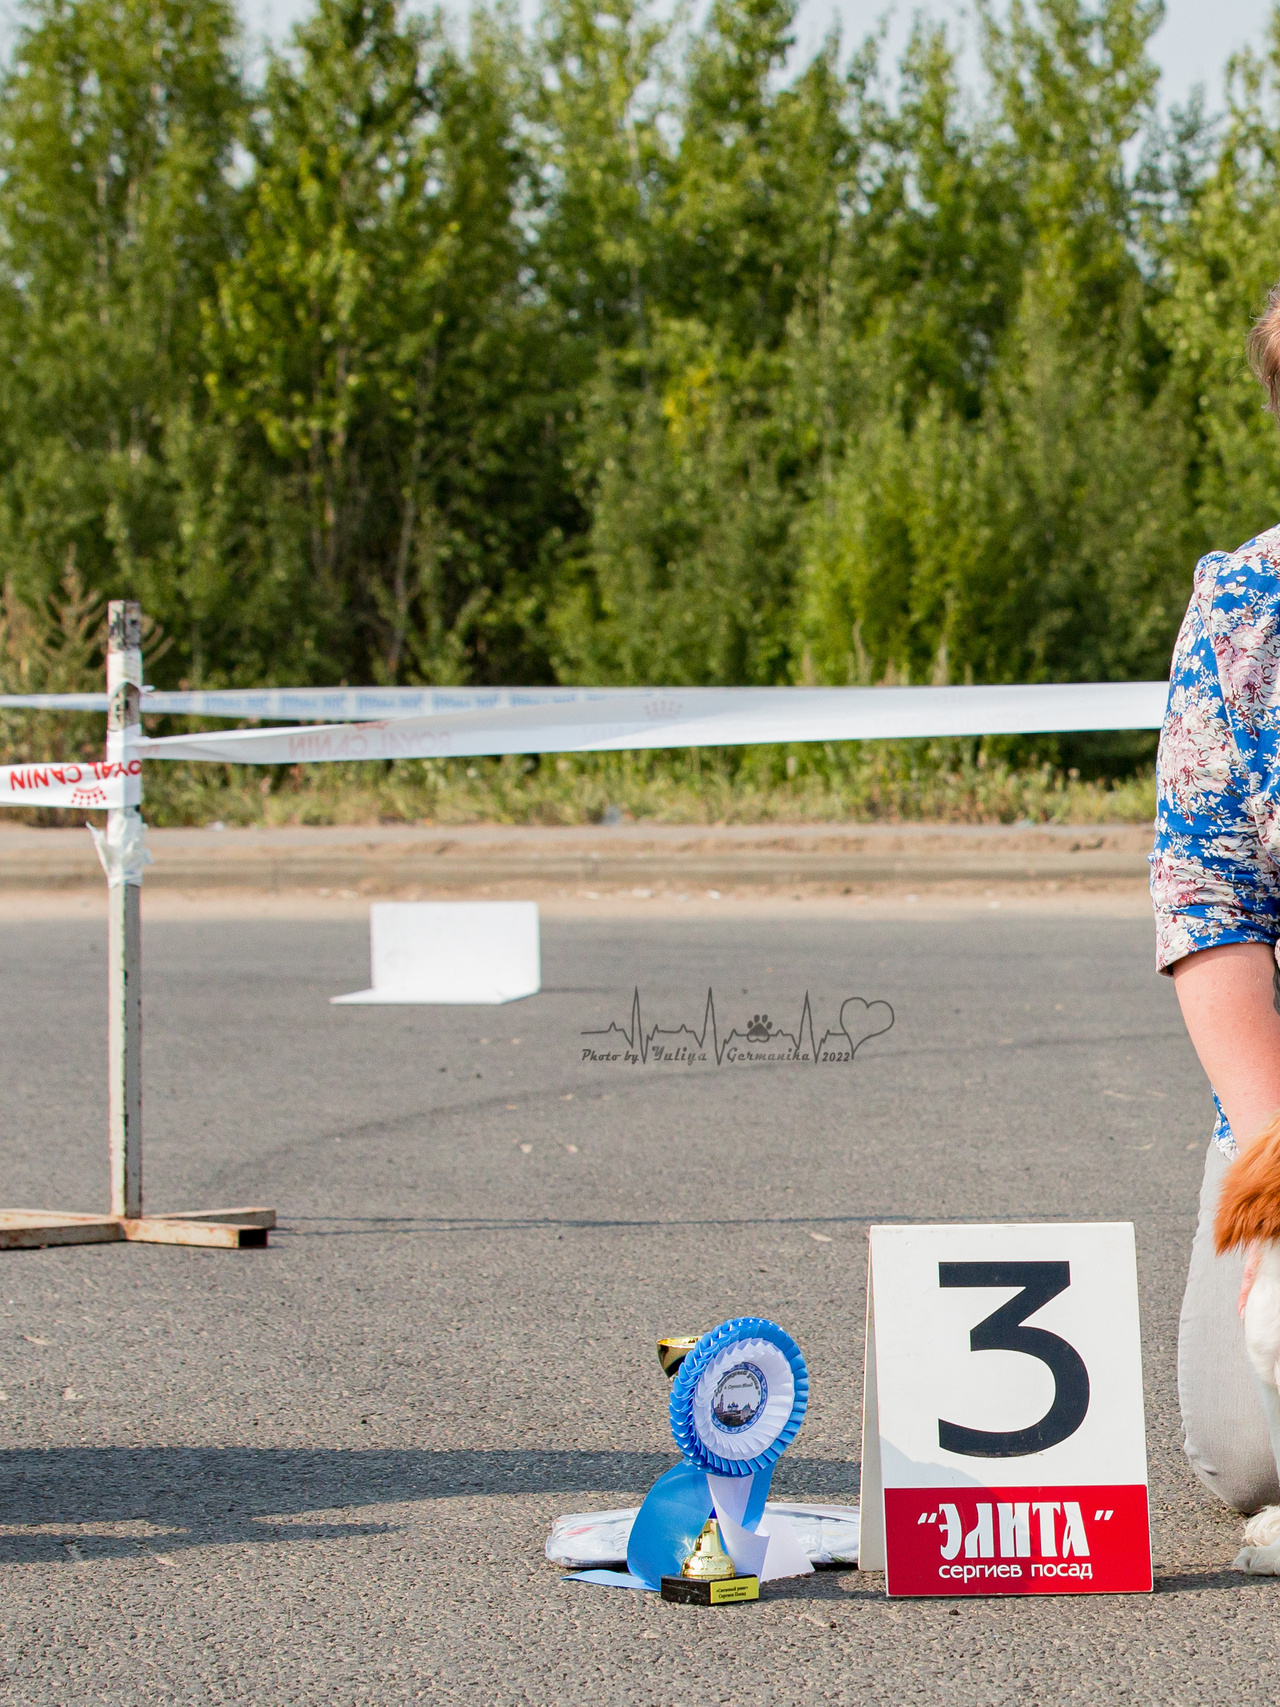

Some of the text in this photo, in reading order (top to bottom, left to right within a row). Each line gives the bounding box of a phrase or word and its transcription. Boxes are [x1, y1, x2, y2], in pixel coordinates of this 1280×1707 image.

[10, 759, 142, 791] OYAL CANIN
[938, 1261, 1091, 1459] 3
[938, 1563, 1093, 1583] сергиев посад
